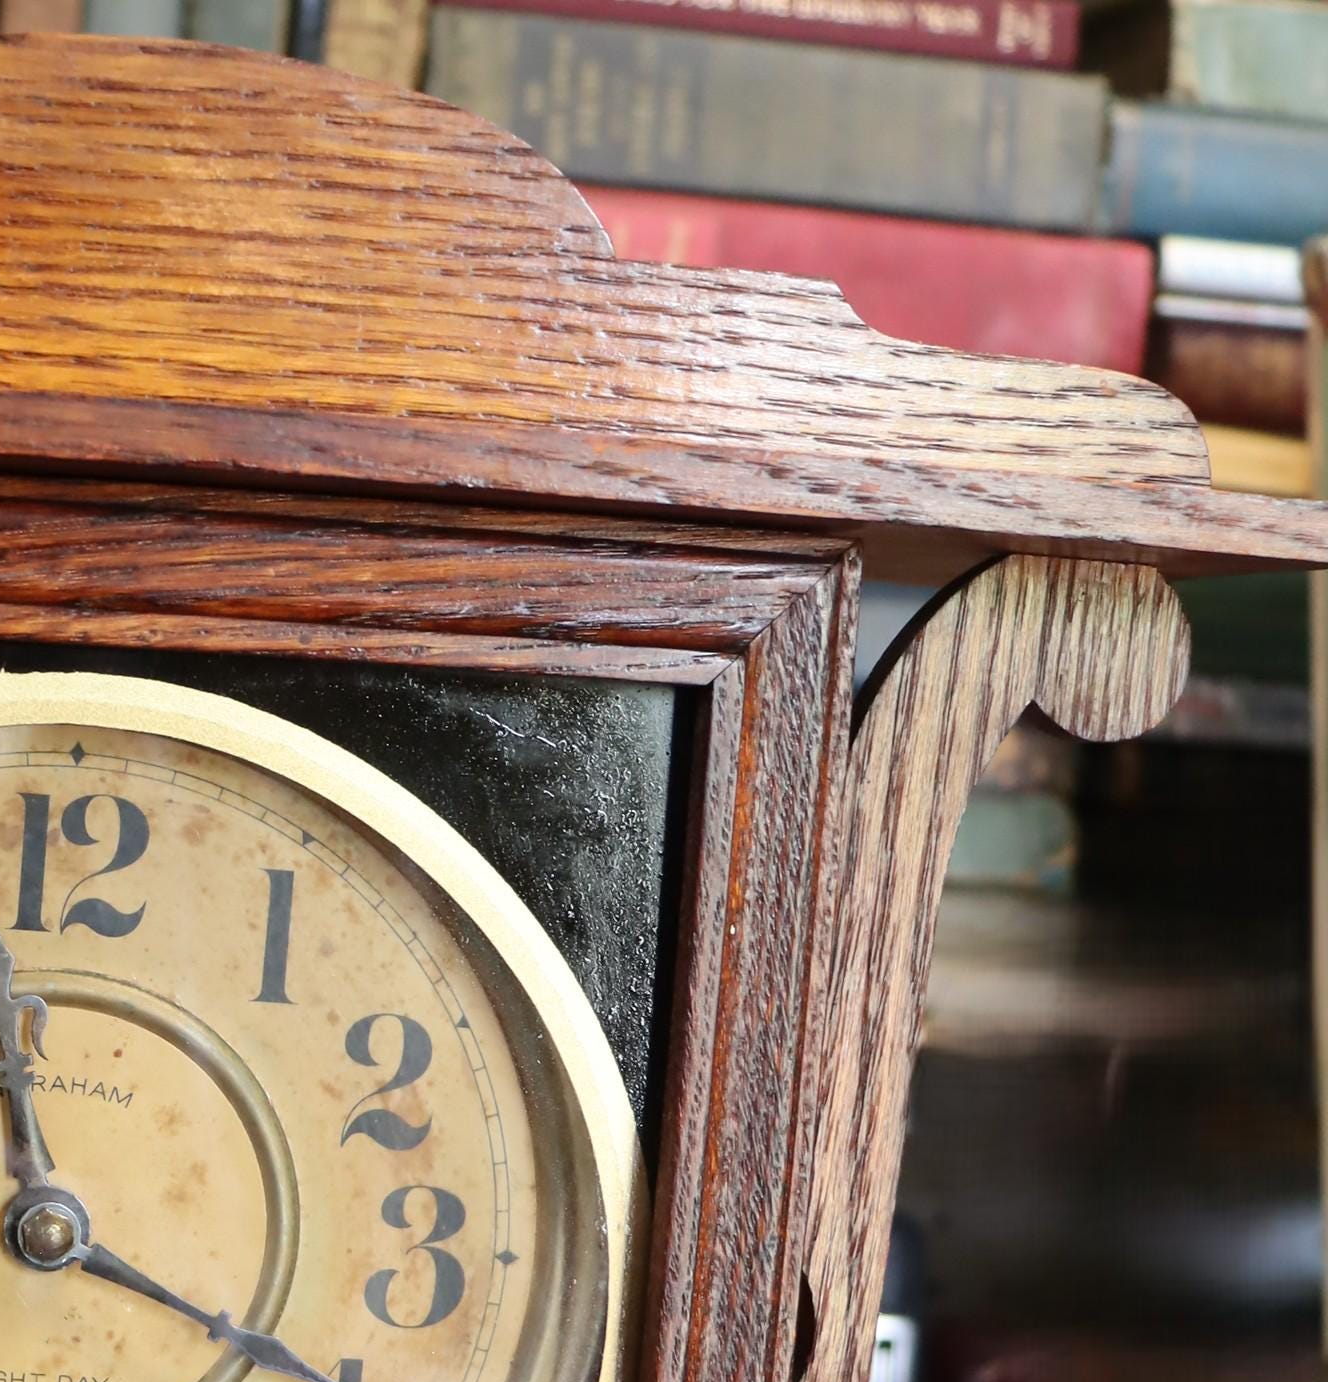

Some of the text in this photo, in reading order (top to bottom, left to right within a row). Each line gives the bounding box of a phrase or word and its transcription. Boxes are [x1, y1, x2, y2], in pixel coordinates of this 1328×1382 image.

[5, 792, 150, 938] 12
[248, 868, 300, 1005] 1
[340, 1012, 433, 1151] 2
[364, 1185, 466, 1329] 3
